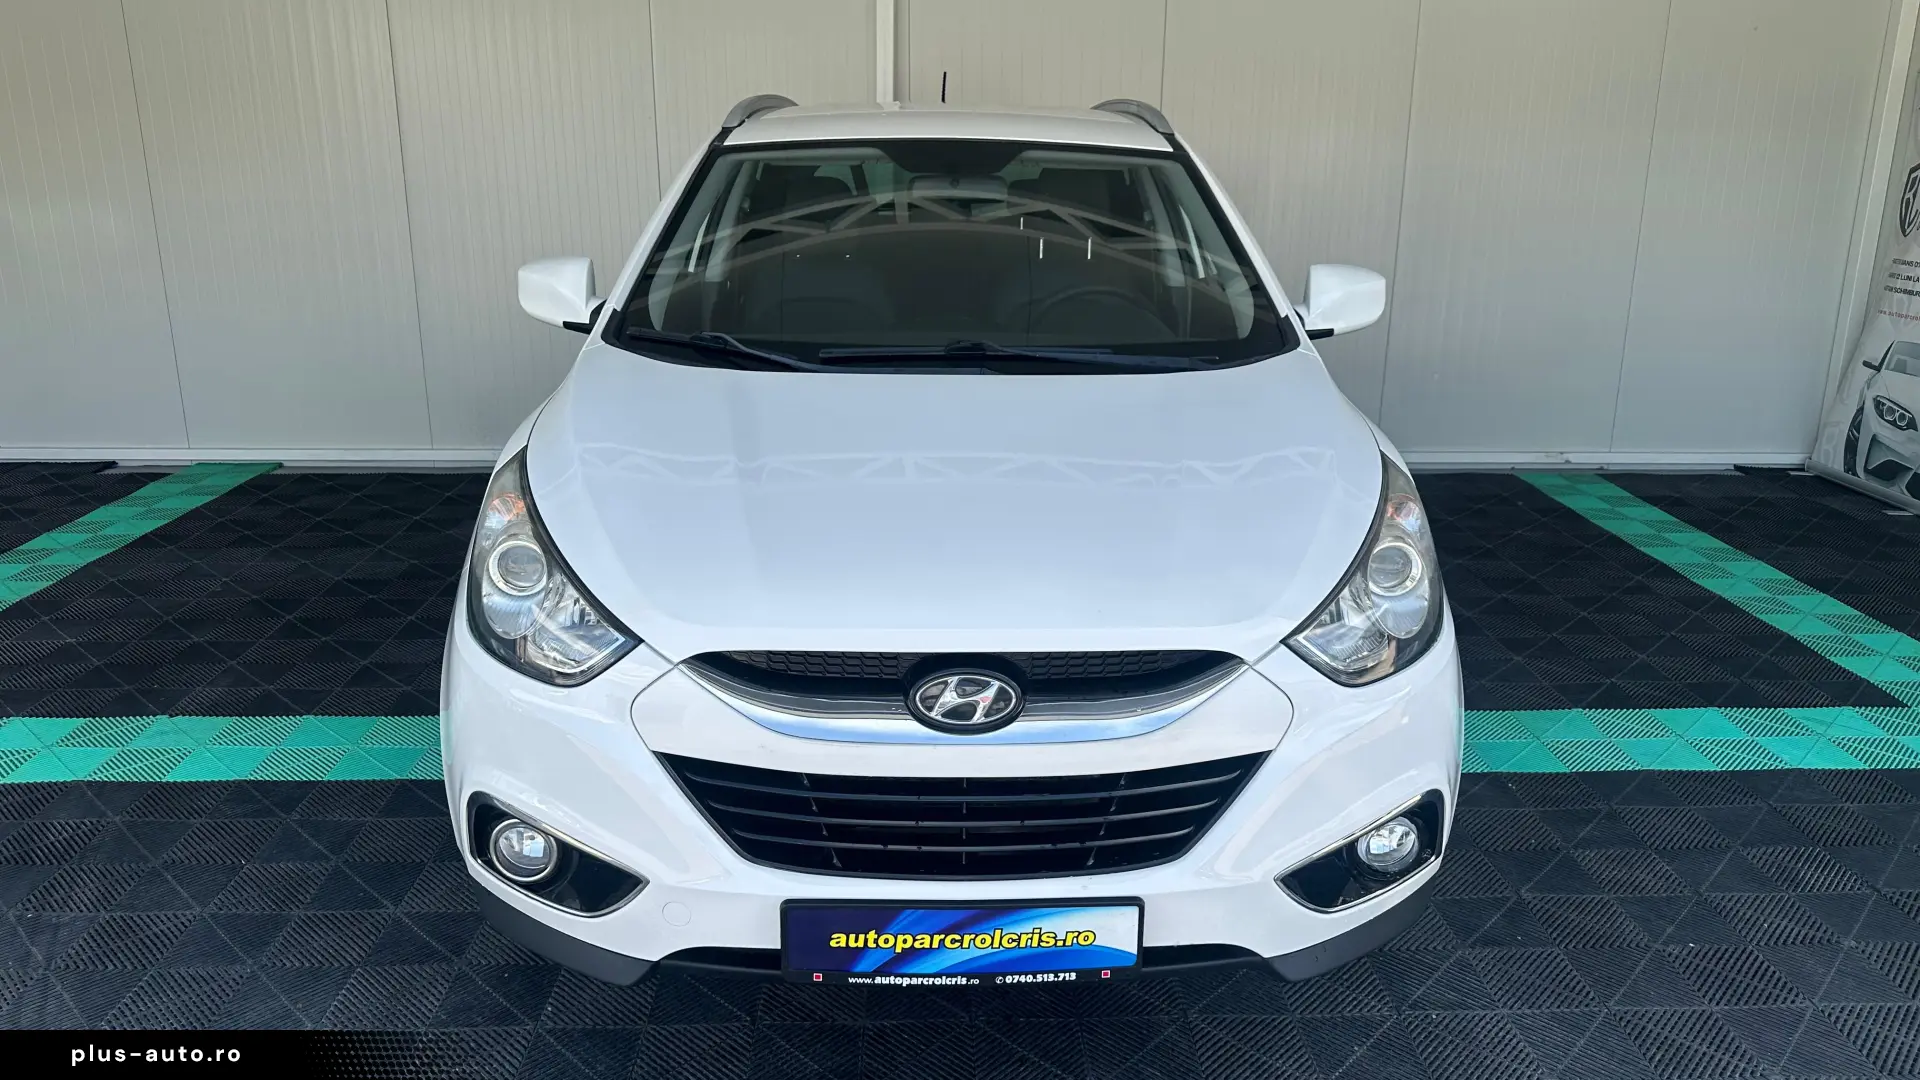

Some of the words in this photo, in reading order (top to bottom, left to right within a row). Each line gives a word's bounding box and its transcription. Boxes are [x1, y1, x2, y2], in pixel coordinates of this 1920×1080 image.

[829, 928, 1096, 954] autoparcrolcris.ro
[848, 974, 980, 987] www.autoparcrolcris.ro
[1005, 972, 1077, 984] 0740.513.713
